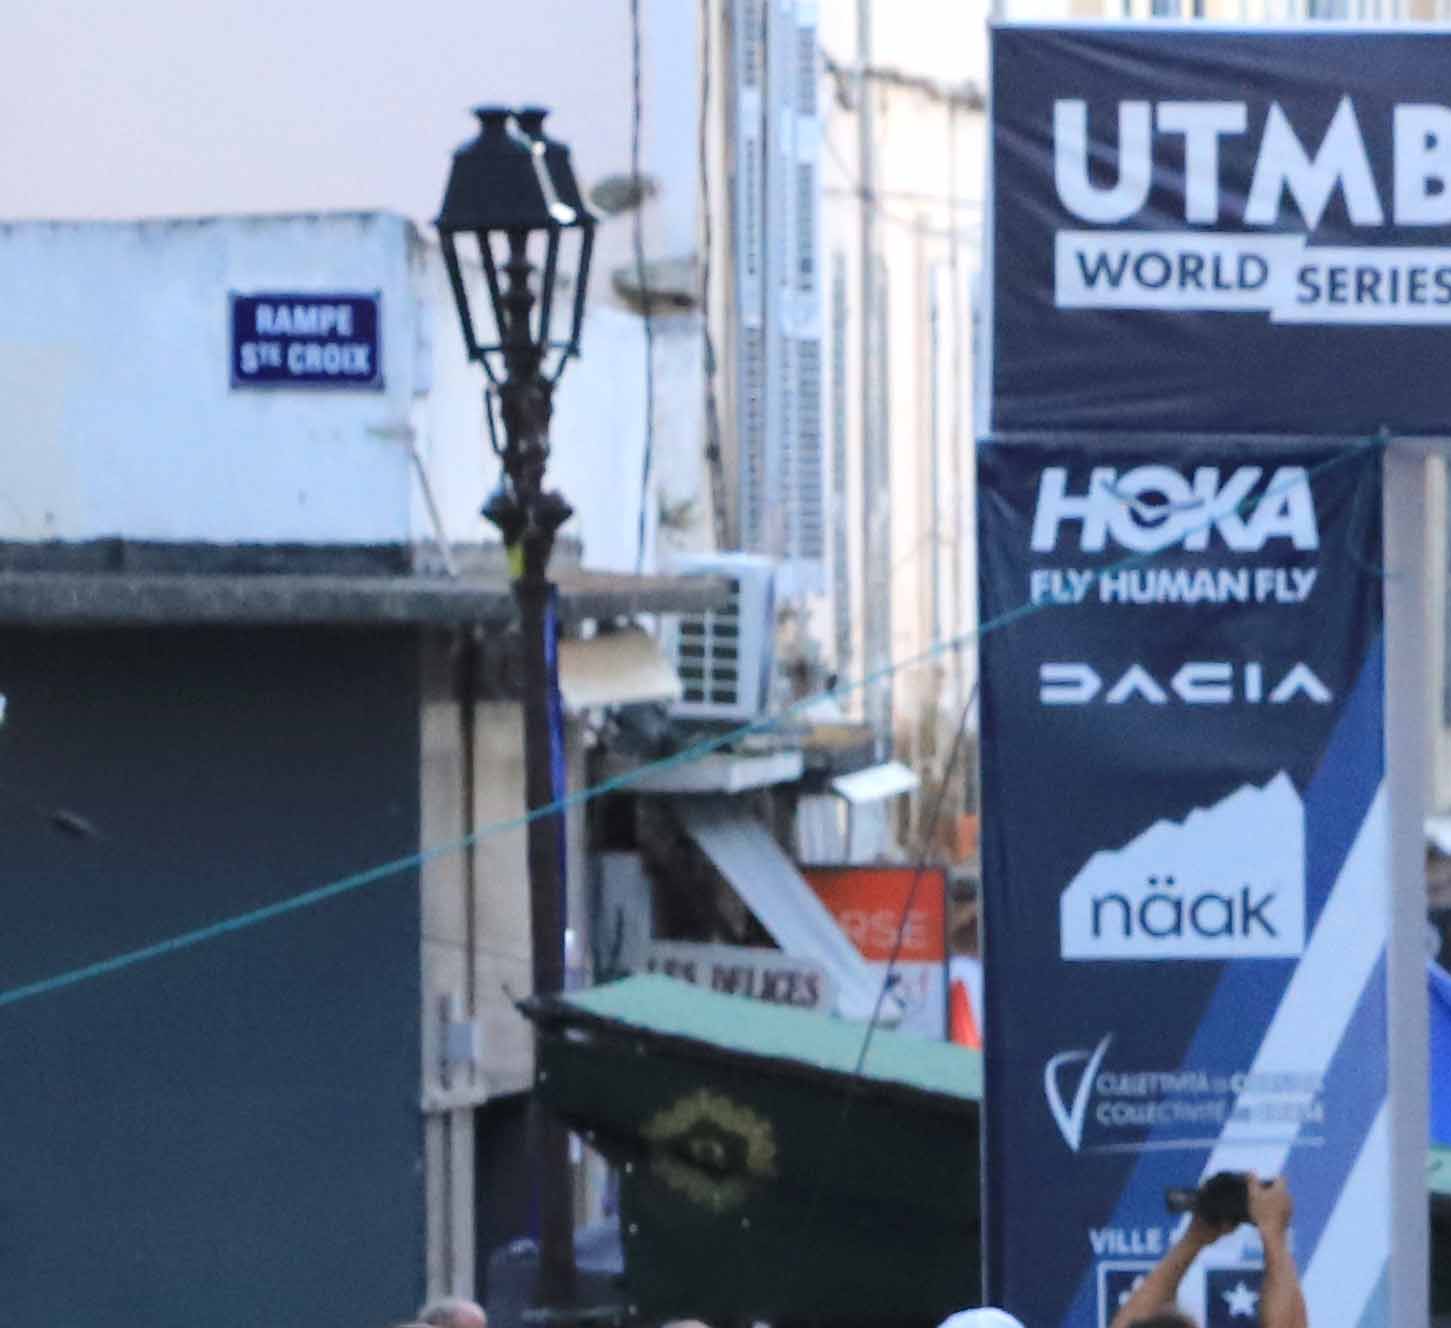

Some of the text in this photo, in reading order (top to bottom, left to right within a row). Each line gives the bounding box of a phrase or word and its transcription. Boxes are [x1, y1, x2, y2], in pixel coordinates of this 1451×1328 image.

[1077, 250, 1269, 293] WORLD
[255, 303, 354, 338] RAMPE
[287, 342, 371, 377] CROIX
[1030, 465, 1319, 553] HOKA
[1030, 566, 1320, 604] FLY HUMAN FLY
[1039, 661, 1335, 706] DACIA
[1090, 875, 1281, 940] näak
[1088, 1228, 1163, 1254] VILLE
